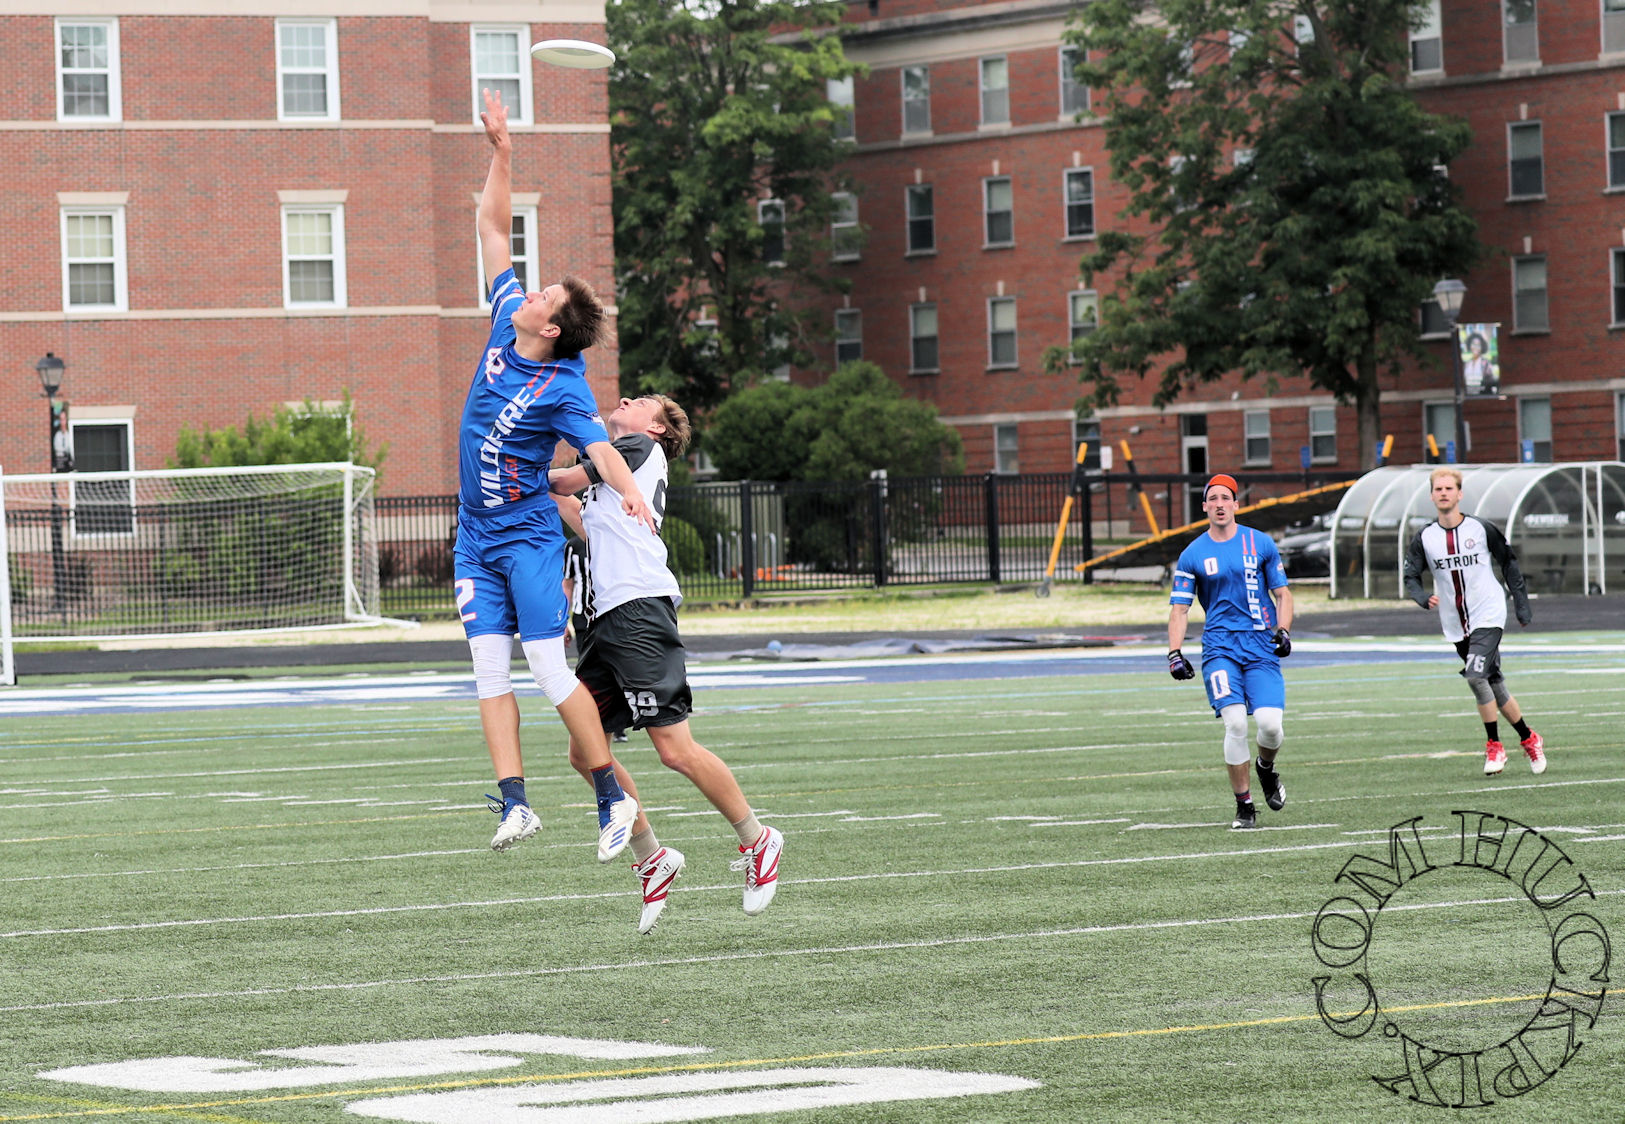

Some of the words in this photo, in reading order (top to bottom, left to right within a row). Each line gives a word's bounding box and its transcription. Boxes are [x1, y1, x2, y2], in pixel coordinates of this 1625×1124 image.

[1203, 557, 1219, 576] 0
[1465, 653, 1486, 673] 76
[1210, 669, 1232, 700] 0
